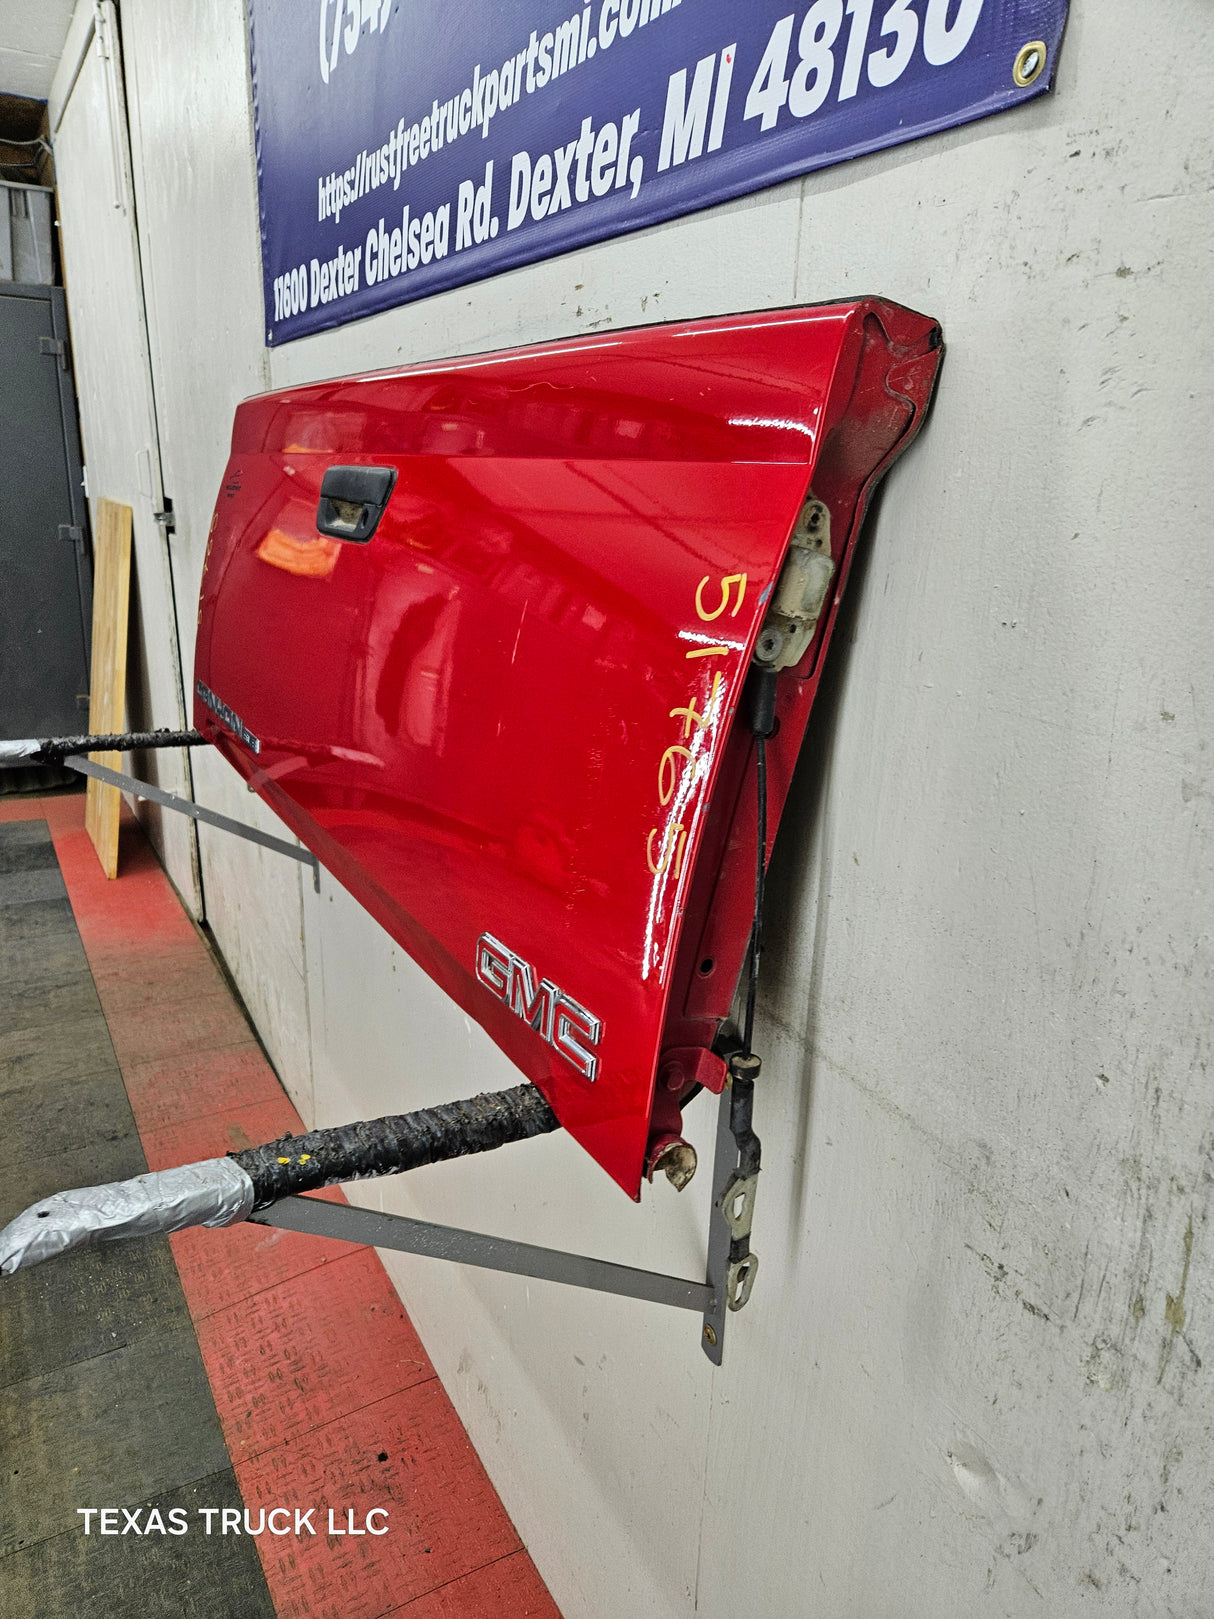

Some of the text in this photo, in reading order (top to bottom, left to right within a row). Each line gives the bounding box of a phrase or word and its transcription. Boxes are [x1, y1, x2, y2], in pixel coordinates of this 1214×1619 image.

[273, 0, 984, 322] 11600 Dexter Chelsea Rd. Dexter, MI 48130
[318, 0, 683, 224] https://rustfreetruckpartsmi.co
[475, 931, 602, 1082] GMC
